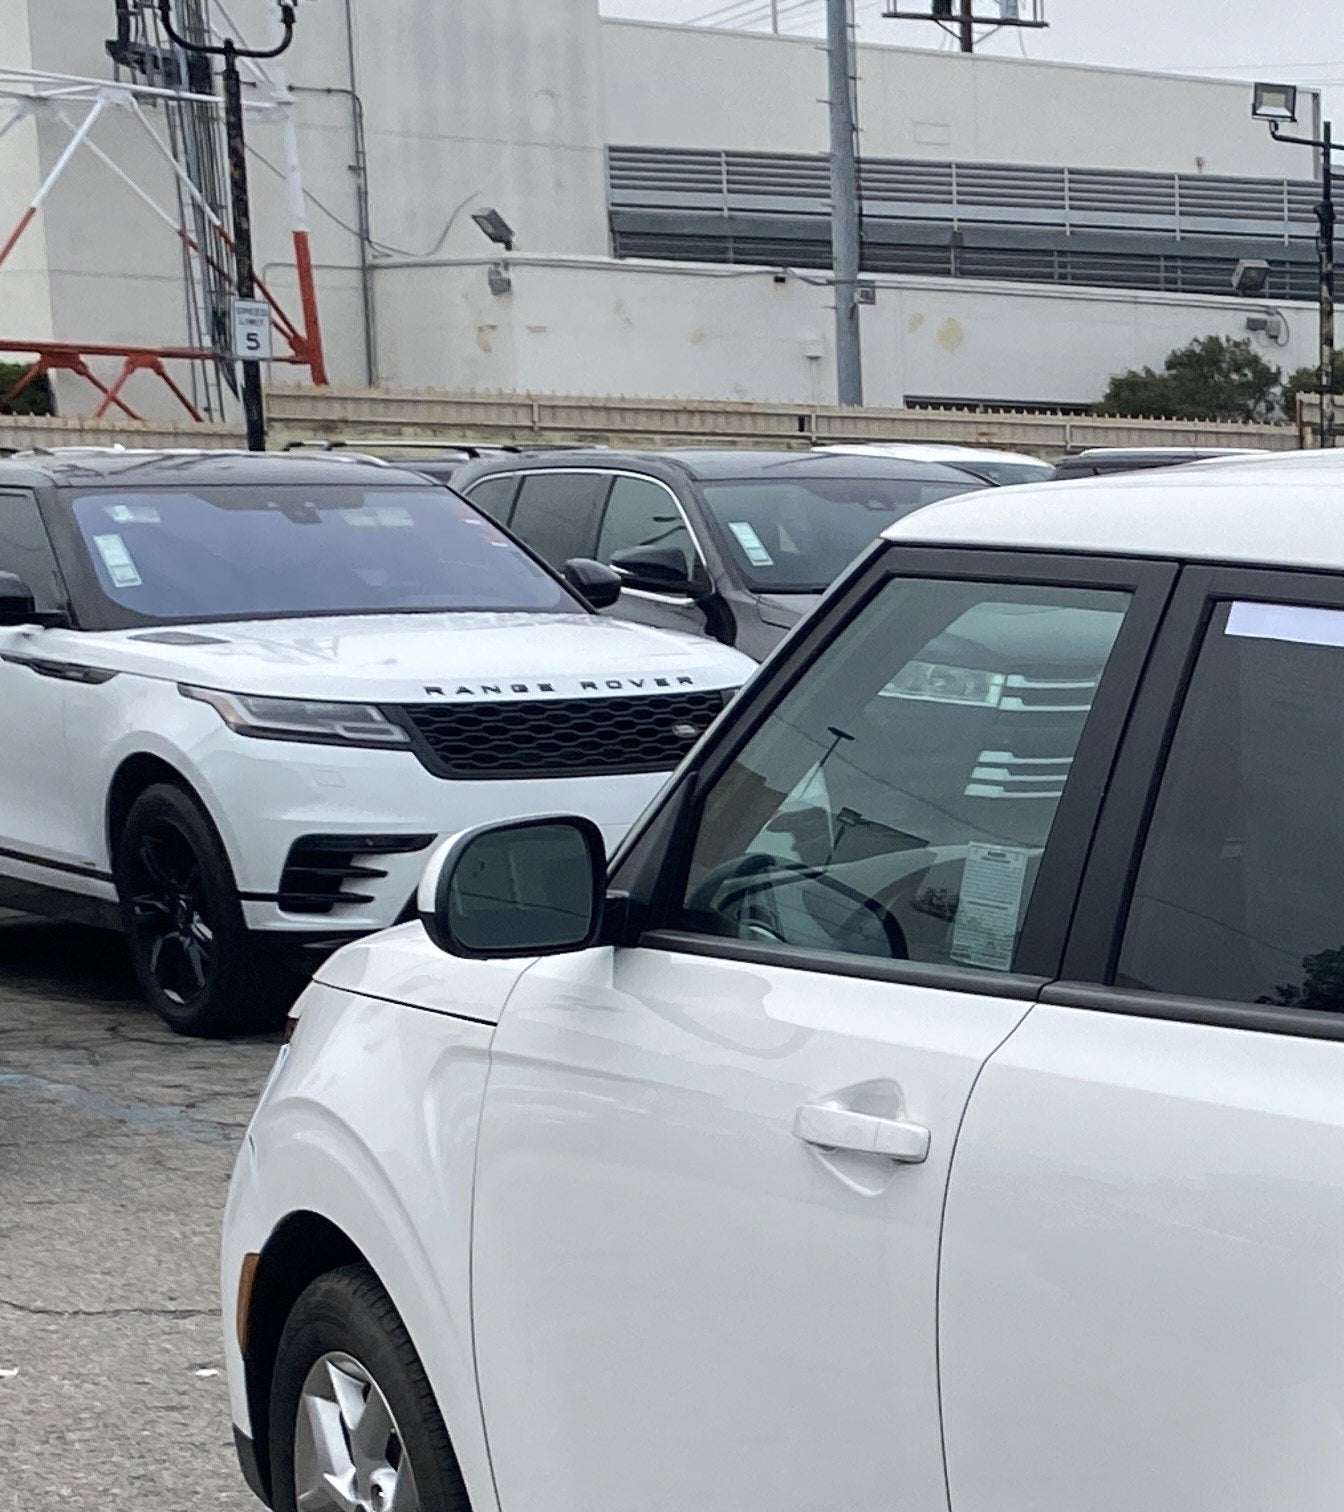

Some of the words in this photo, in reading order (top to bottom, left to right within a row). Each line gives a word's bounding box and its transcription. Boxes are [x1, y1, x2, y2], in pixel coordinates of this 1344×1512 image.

[246, 332, 260, 350] 5
[423, 683, 556, 696] RANGE
[578, 676, 694, 691] ROVER
